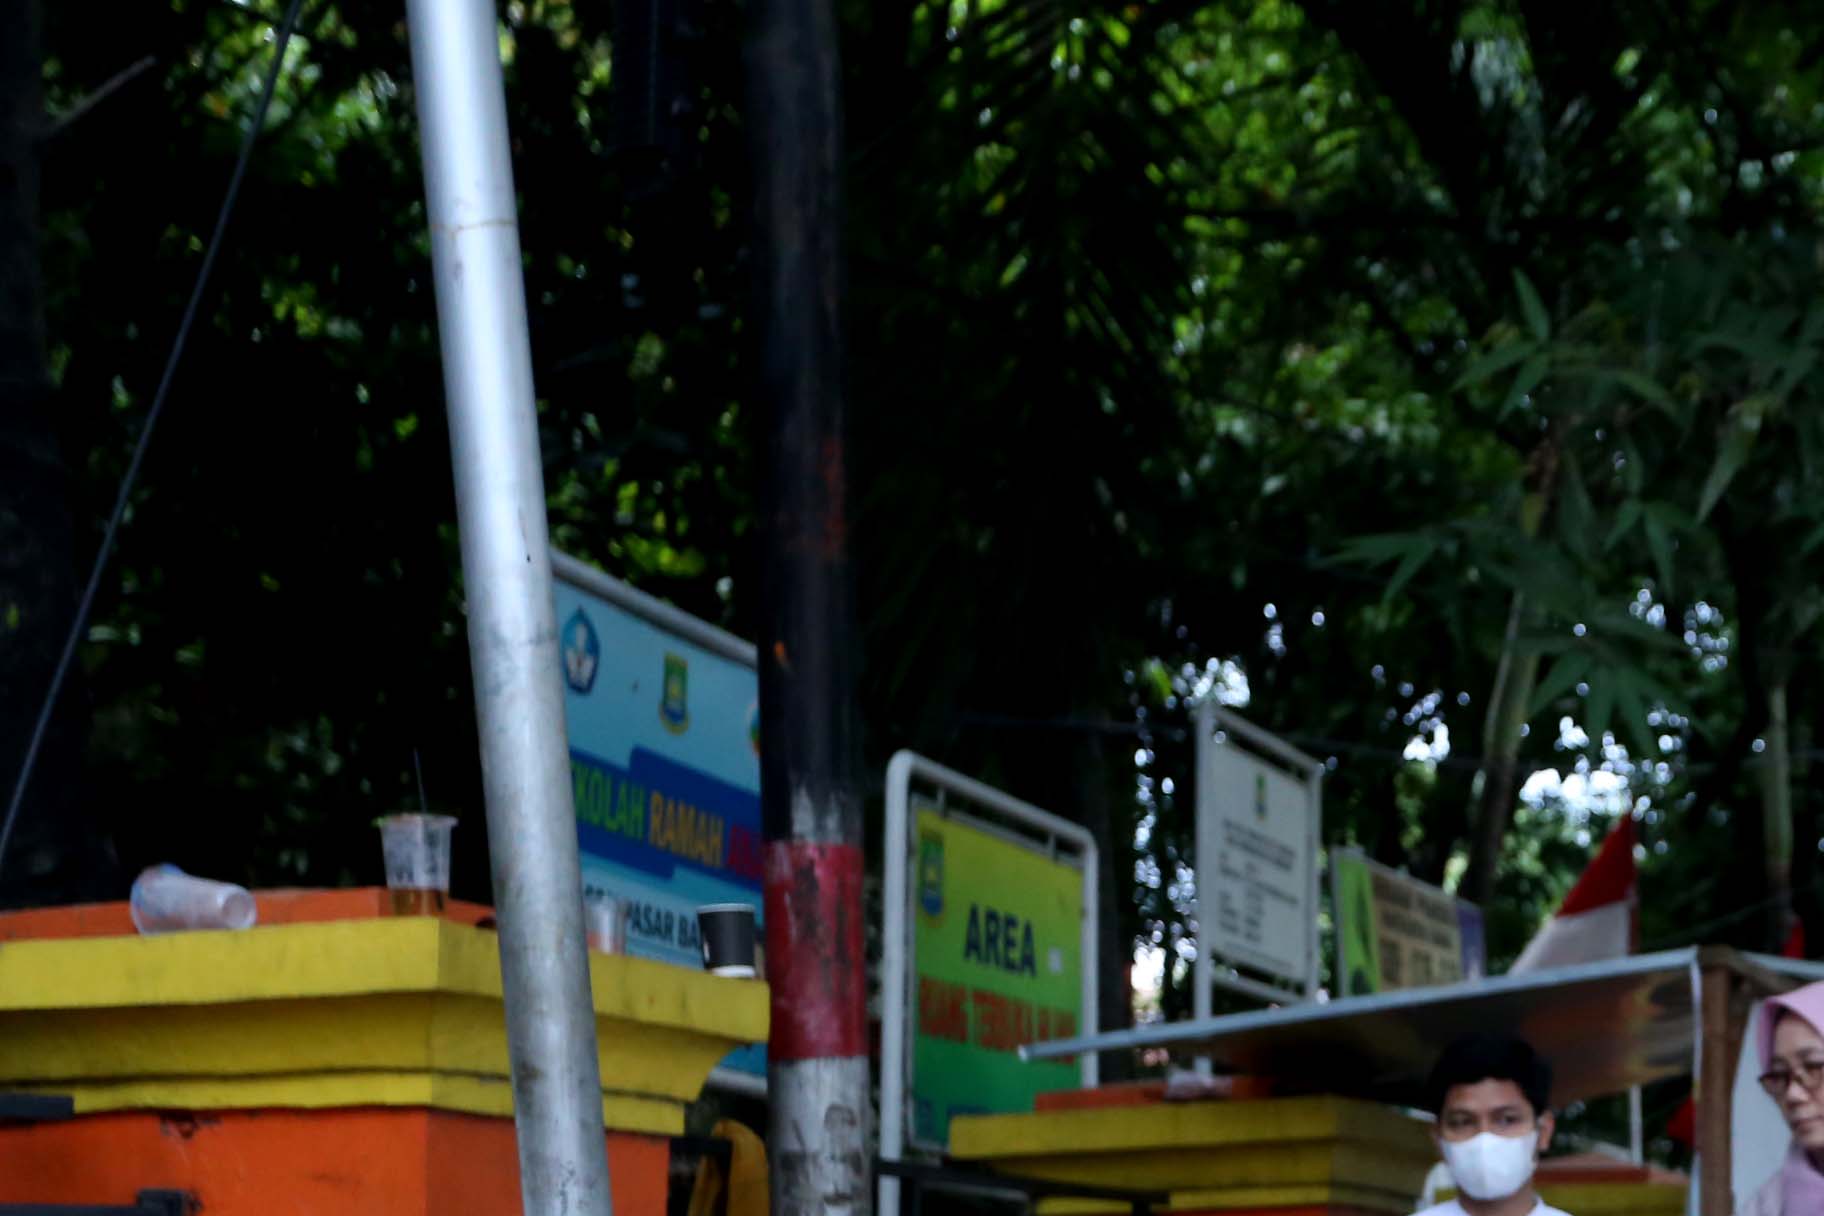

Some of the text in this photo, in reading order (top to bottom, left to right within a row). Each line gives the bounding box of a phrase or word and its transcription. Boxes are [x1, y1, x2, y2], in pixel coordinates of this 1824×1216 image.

[571, 760, 644, 840] KOLAH
[649, 789, 723, 868] RAMAH
[964, 903, 1037, 977] AREA
